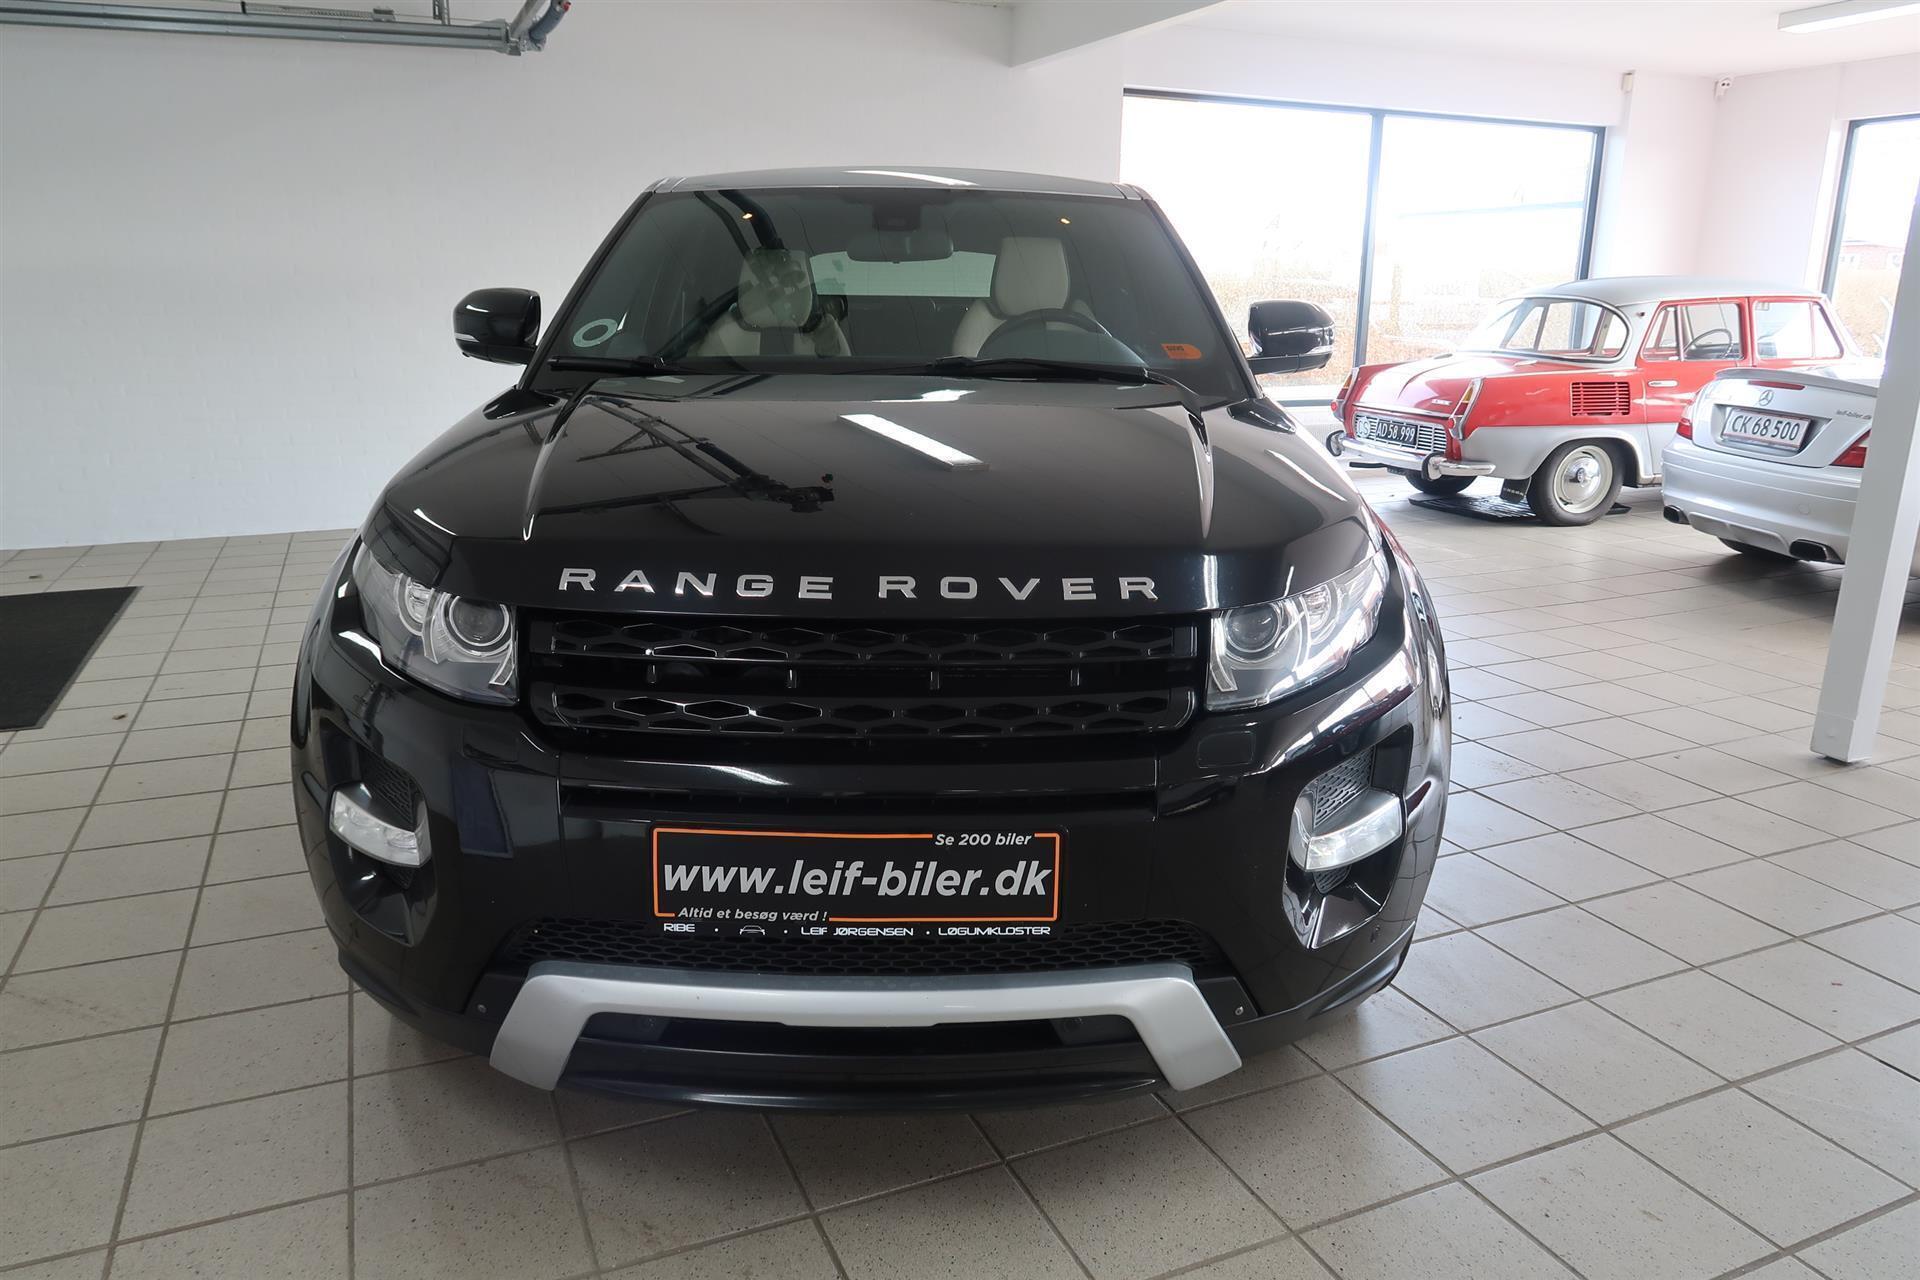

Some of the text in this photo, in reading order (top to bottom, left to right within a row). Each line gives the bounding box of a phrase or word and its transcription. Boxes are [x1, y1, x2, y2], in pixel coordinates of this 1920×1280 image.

[1376, 422, 1388, 438] AD
[1731, 414, 1800, 441] CK 68 500
[558, 567, 1159, 601] RANGE ROVER
[934, 832, 1032, 846] Se 200 biler
[664, 859, 1053, 897] www.leif-biler.dk
[678, 906, 713, 919] Altid
[716, 908, 732, 919] et
[734, 908, 778, 922] besøg
[782, 910, 819, 922] værd
[663, 922, 696, 933] RIBE
[800, 926, 915, 937] LEIF JØRGENSEN
[937, 926, 1051, 936] LØGUMKLOSTER
